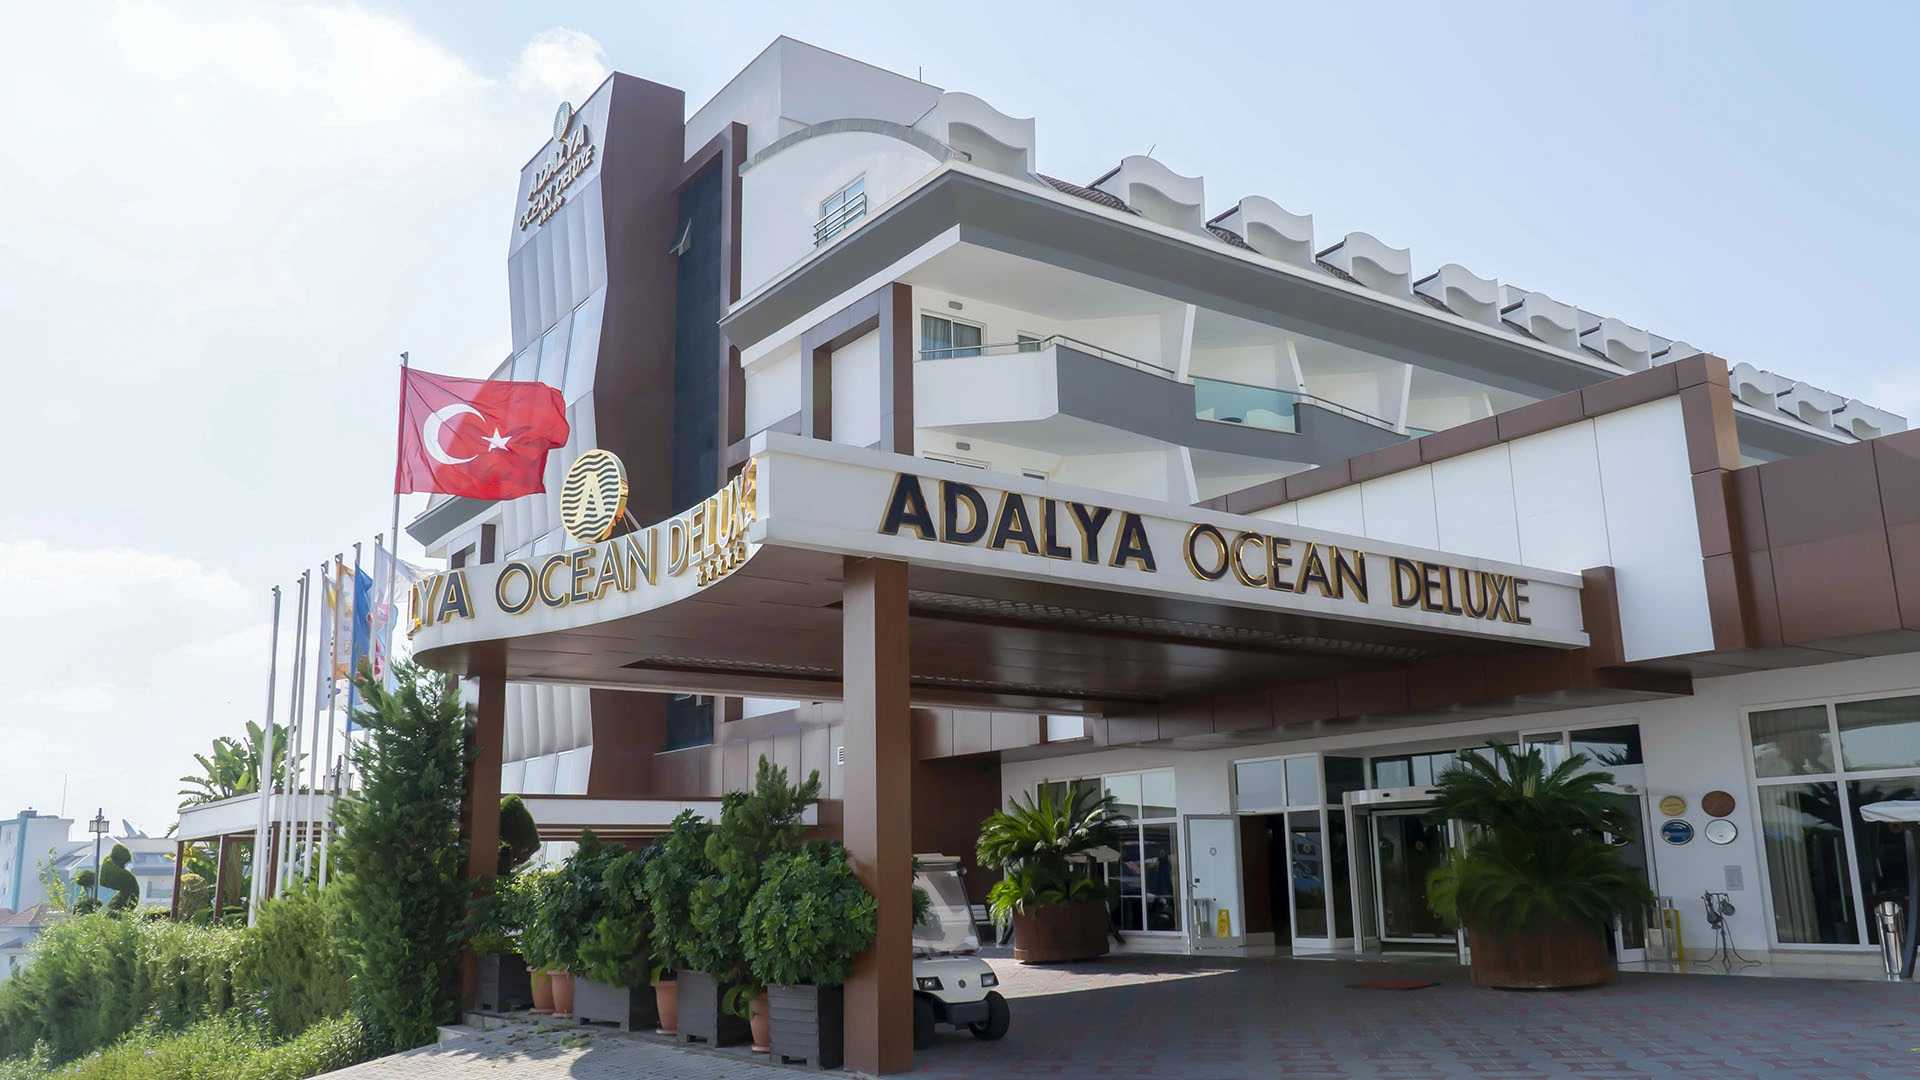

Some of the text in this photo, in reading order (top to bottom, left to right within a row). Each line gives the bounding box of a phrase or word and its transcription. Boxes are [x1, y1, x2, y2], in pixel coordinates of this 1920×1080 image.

[520, 144, 595, 231] OCEAN DELUXE
[528, 124, 588, 201] ADALYA
[494, 528, 657, 615] OCEAN
[667, 457, 756, 577] DELUXE
[574, 472, 609, 524] A
[878, 472, 1532, 625] ADALYA OCEAN DELUXE
